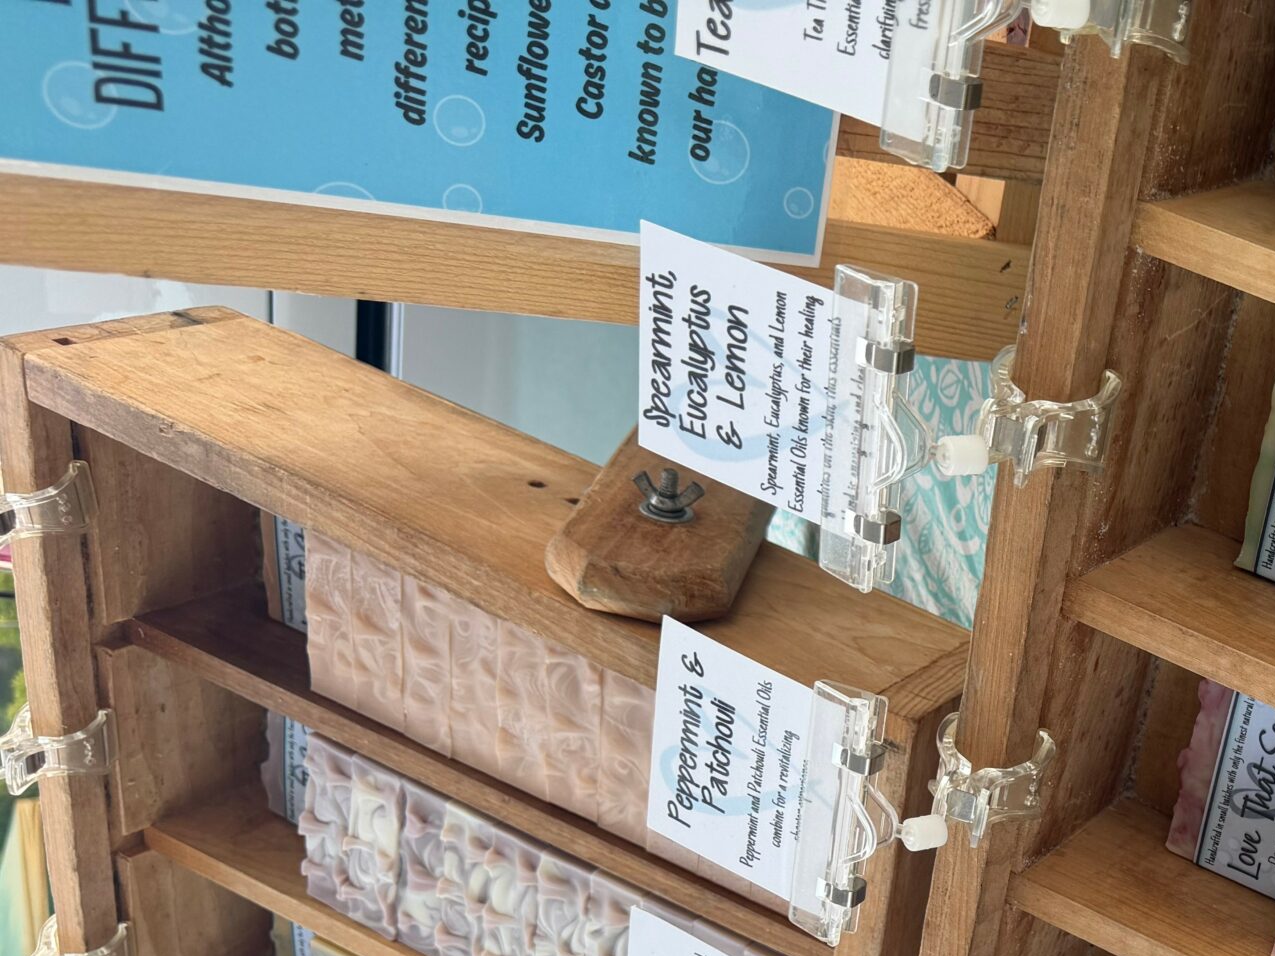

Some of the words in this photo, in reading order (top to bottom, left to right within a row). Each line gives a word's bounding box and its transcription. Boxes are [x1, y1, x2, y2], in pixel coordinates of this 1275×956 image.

[636, 23, 666, 56] to
[803, 18, 824, 41] Tea
[575, 14, 609, 120] Castor
[628, 61, 663, 165] known
[689, 109, 713, 162] our
[768, 291, 787, 333] Lemon
[798, 295, 824, 339] healing
[642, 270, 677, 428] Spearmint,
[678, 284, 715, 439] Eucalyptus
[716, 305, 749, 410] Lemon
[768, 335, 785, 359] and
[796, 340, 813, 371] their
[763, 363, 788, 428] Eucalyptus,
[794, 373, 812, 394] for
[791, 397, 810, 434] known
[715, 421, 742, 450] &
[790, 435, 808, 459] Oils
[760, 433, 784, 496] Spearmint,
[787, 460, 806, 513] Essential
[680, 651, 704, 678] &
[756, 680, 773, 700] Oils
[752, 700, 771, 747] Essential
[1240, 700, 1255, 726] natural
[1231, 745, 1244, 756] the
[1234, 725, 1248, 744] finest
[666, 683, 703, 829] Peppermint
[701, 696, 736, 814] Patchouli
[746, 747, 766, 793] Patchouli
[776, 730, 800, 783] revitalizing
[1228, 755, 1245, 770] only
[1219, 784, 1234, 806] batches
[1226, 770, 1237, 784] with
[747, 793, 760, 813] and
[771, 791, 786, 808] for
[1217, 806, 1229, 823] small
[739, 813, 761, 868] Peppermint
[769, 809, 785, 848] combine
[1204, 829, 1222, 866] Handcrafted
[1227, 830, 1262, 880] Love
